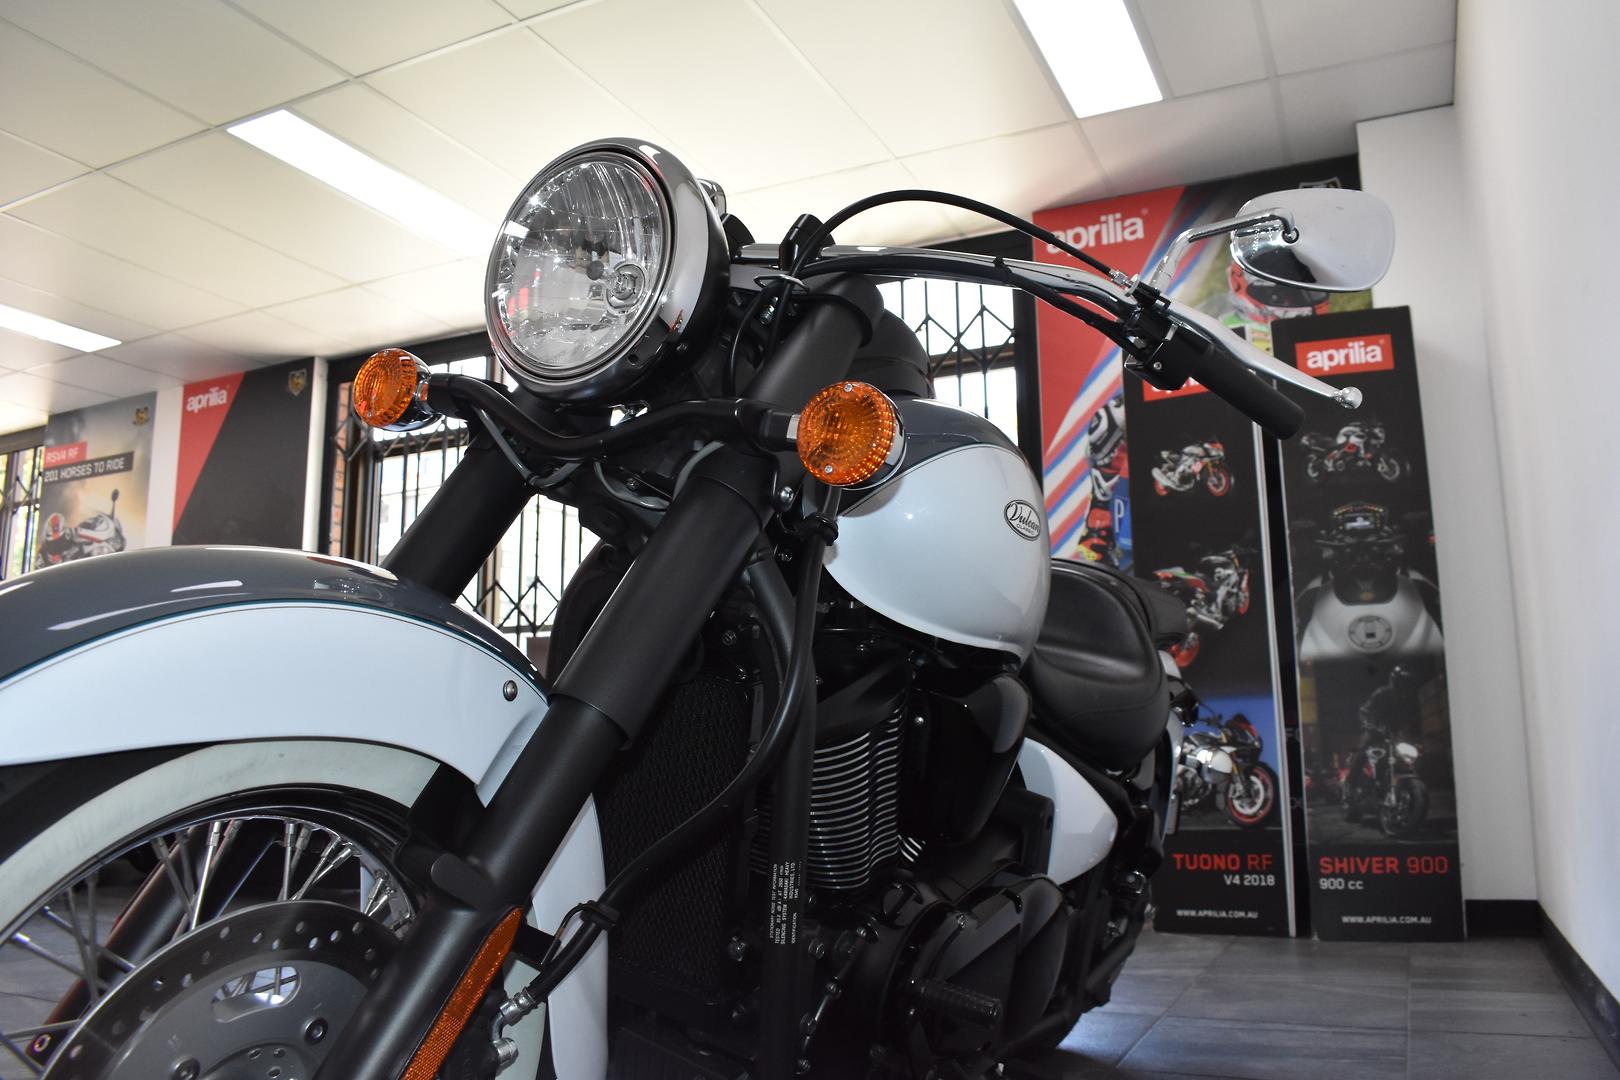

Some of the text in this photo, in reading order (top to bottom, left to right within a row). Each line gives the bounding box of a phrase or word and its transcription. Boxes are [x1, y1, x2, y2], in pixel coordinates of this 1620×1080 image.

[1046, 212, 1144, 256] aprilia
[1306, 340, 1383, 371] aprilia
[186, 386, 227, 413] aprilia
[60, 463, 93, 479] HORSES
[93, 460, 105, 473] TO
[106, 457, 125, 471] RIDE
[1173, 853, 1273, 870] TUONO RF
[1319, 856, 1449, 874] SHIVER 900
[1223, 874, 1276, 886] V4 2018
[1319, 878, 1364, 890] 900 cc
[1176, 909, 1259, 919] WWW.APRILIA.COM.AU
[1341, 915, 1432, 924] WWW.APRILIA.COM.AU
